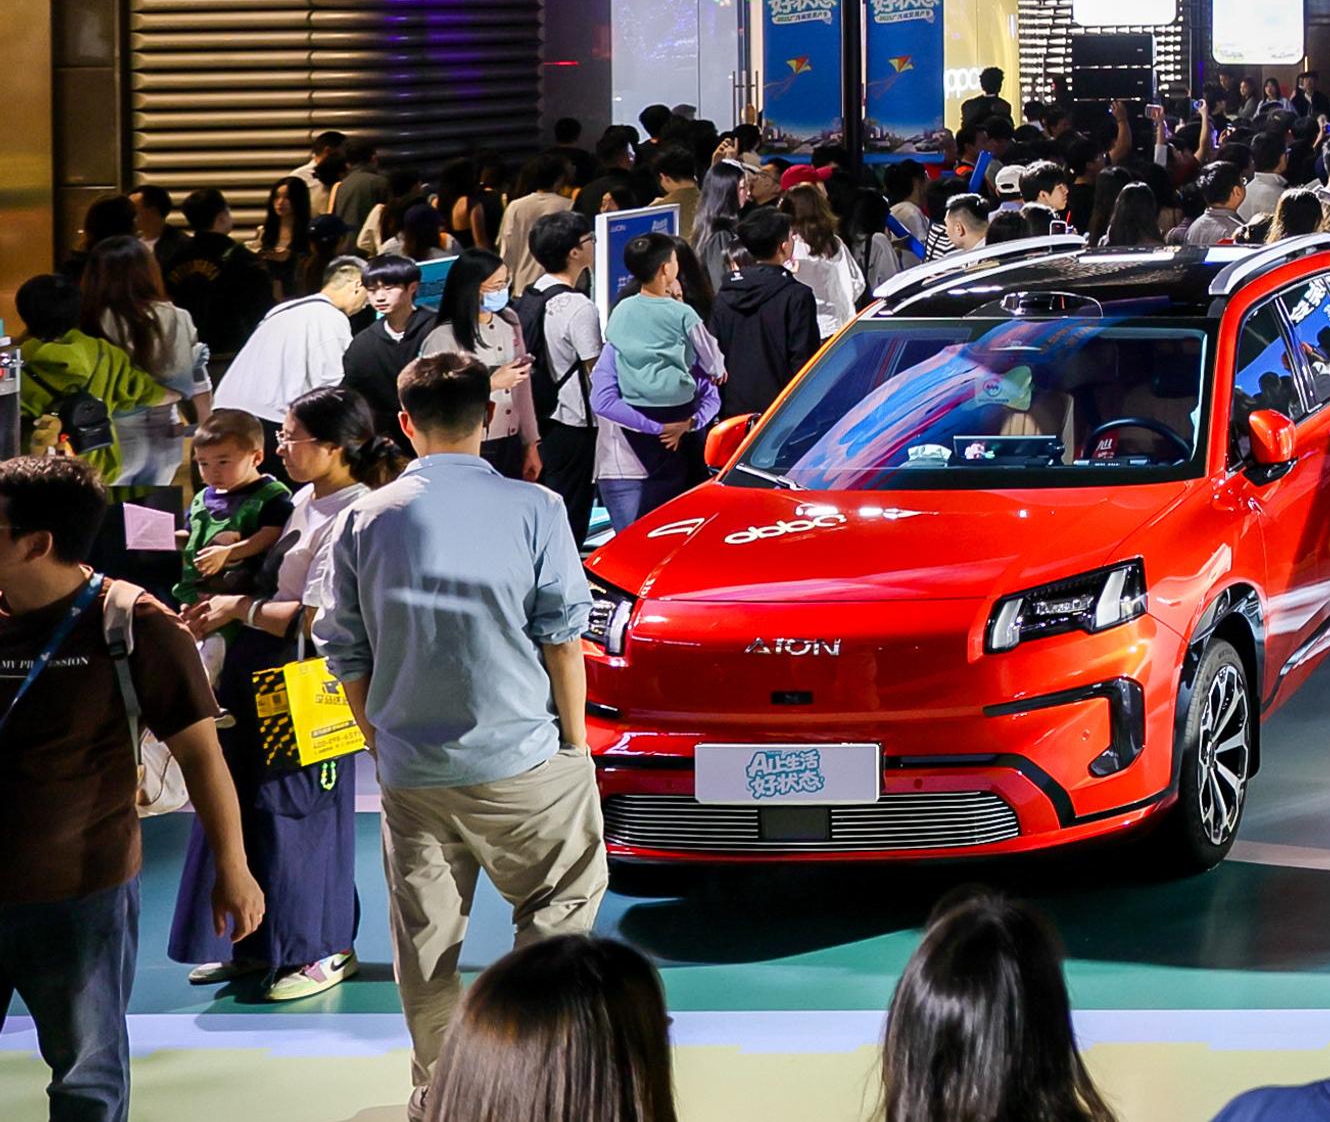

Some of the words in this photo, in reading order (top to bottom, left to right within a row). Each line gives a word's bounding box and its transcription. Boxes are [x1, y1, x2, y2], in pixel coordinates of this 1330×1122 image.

[944, 66, 983, 99] ppo
[744, 637, 842, 656] AION
[750, 770, 823, 798] 好状态
